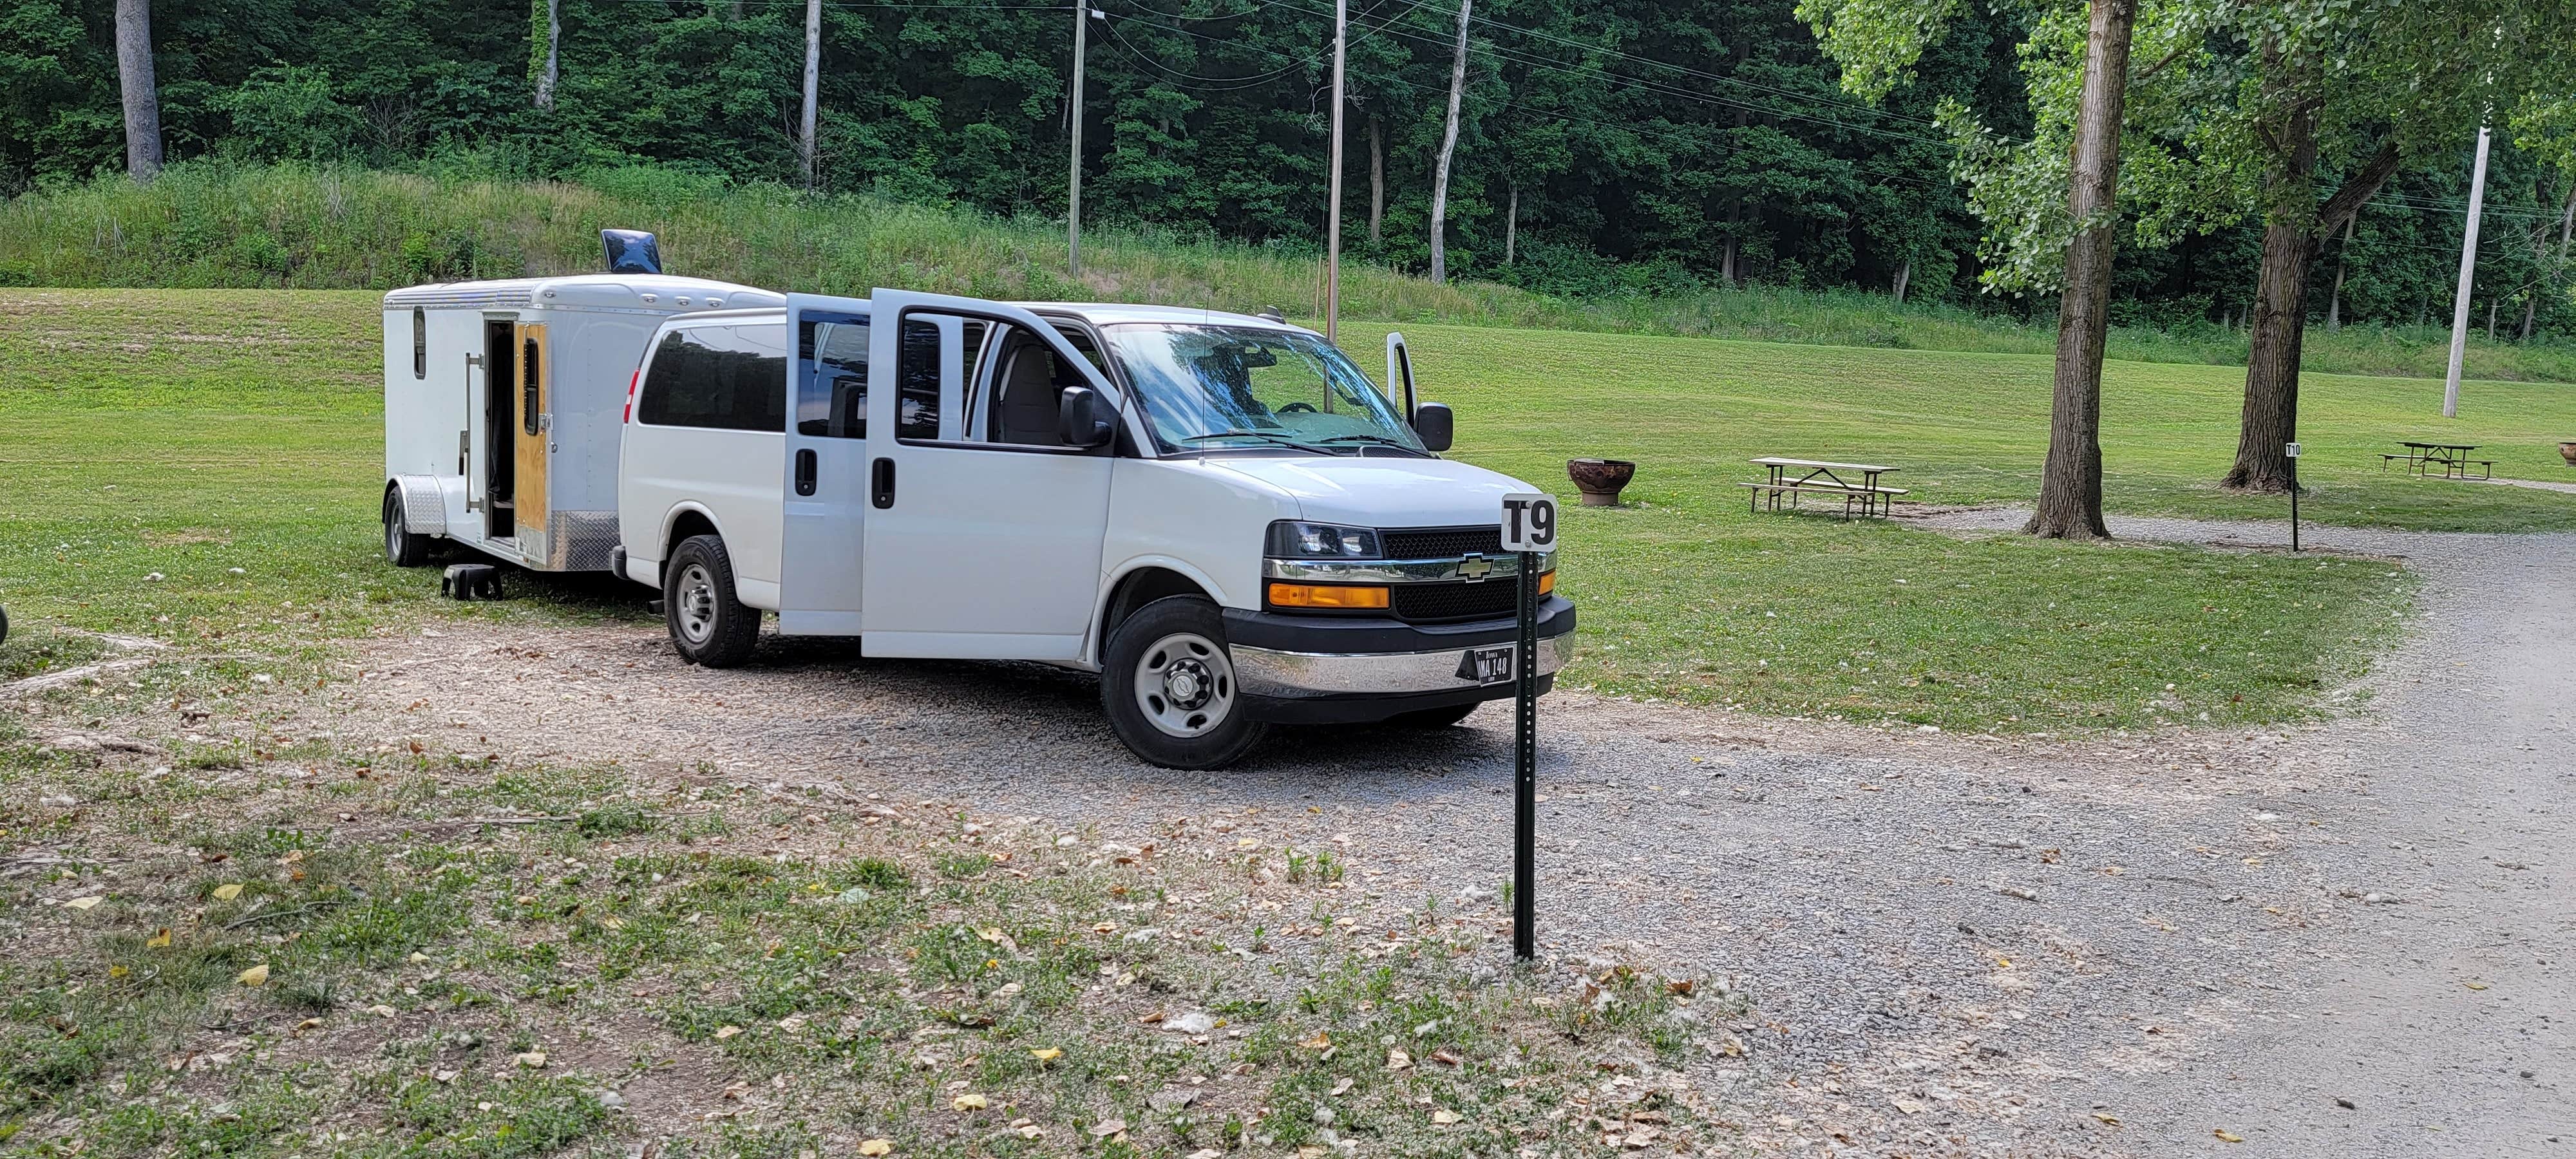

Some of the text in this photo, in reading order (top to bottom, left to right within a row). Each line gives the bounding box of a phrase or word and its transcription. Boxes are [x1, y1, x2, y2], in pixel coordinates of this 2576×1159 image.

[2287, 444, 2300, 455] T10
[1504, 500, 1555, 545] T9
[1492, 657, 1507, 675] 148
